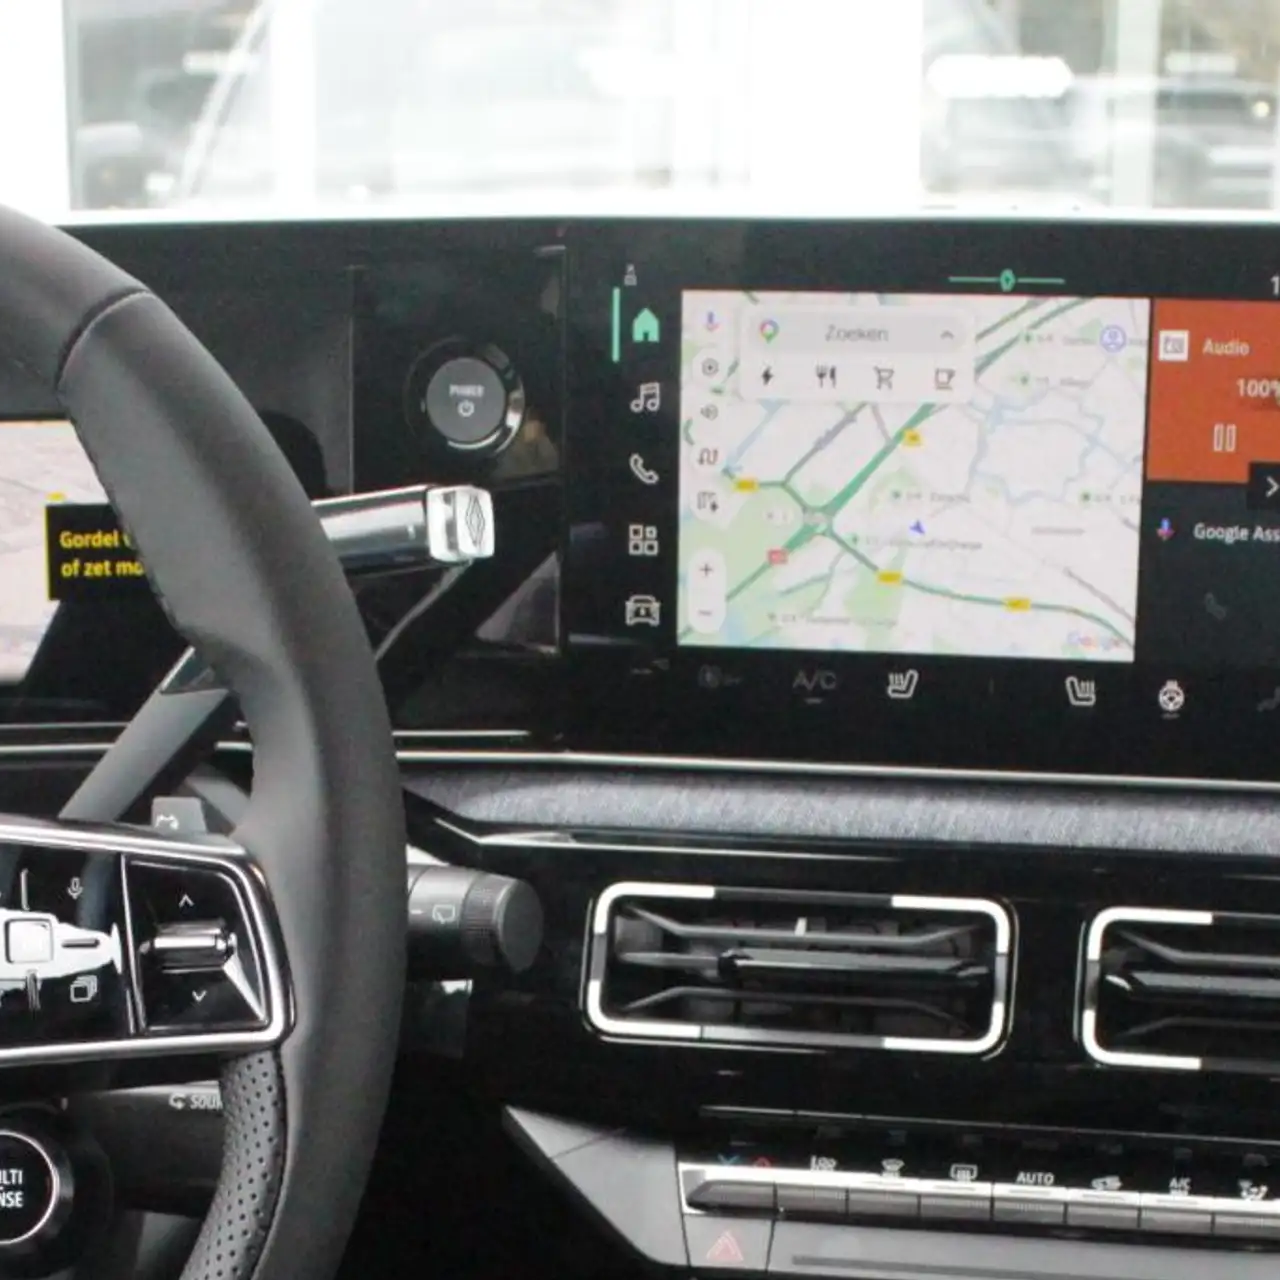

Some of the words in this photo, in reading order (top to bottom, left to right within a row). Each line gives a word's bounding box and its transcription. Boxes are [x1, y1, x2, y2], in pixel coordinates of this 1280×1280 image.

[825, 325, 889, 342] Zoeken
[1202, 336, 1251, 357] Audio
[59, 530, 119, 549] Gordel
[1193, 522, 1249, 545] Google
[61, 559, 80, 578] of
[84, 560, 112, 577] zet
[792, 672, 837, 690] A/C
[1016, 1171, 1055, 1186] AUTO
[1169, 1177, 1191, 1190] A/C
